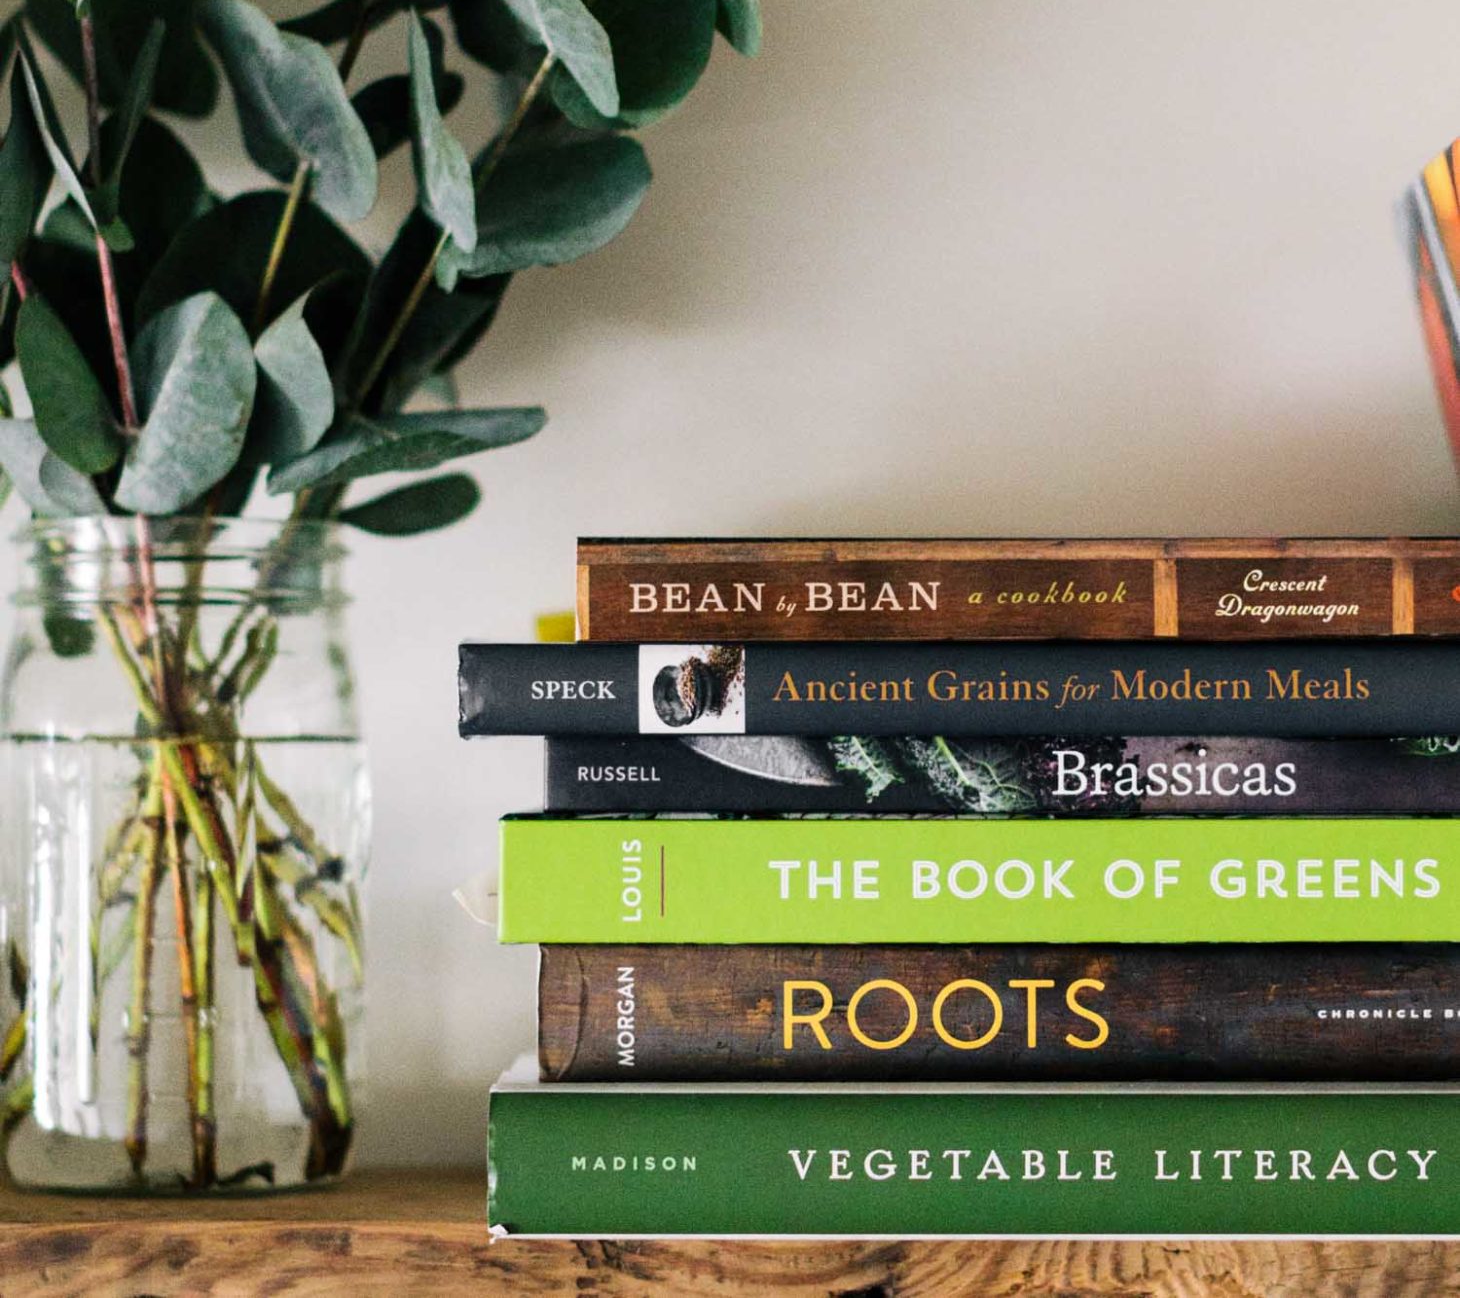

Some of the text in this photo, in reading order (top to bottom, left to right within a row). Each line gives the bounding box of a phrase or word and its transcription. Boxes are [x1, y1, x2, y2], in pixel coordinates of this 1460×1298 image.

[1243, 570, 1327, 592] Crescent
[630, 582, 1128, 617] BEAN by BEAN a cookbook
[1215, 594, 1359, 622] Dragonwagon
[531, 681, 616, 699] SPECK
[772, 668, 1370, 708] Ancient Grains for Modern Meals
[578, 767, 661, 782] RUSSELL
[1052, 749, 1296, 797] Brassicas
[622, 839, 642, 922] LOUIS
[769, 858, 1440, 899] THE BOOK OF GREENS
[618, 966, 634, 1066] MORGAN
[783, 979, 1109, 1050] ROOTS
[1317, 1008, 1433, 1020] CHRONICLE
[572, 1157, 697, 1171] MADISON
[788, 1150, 1437, 1180] VEGETABLE LITERACY
